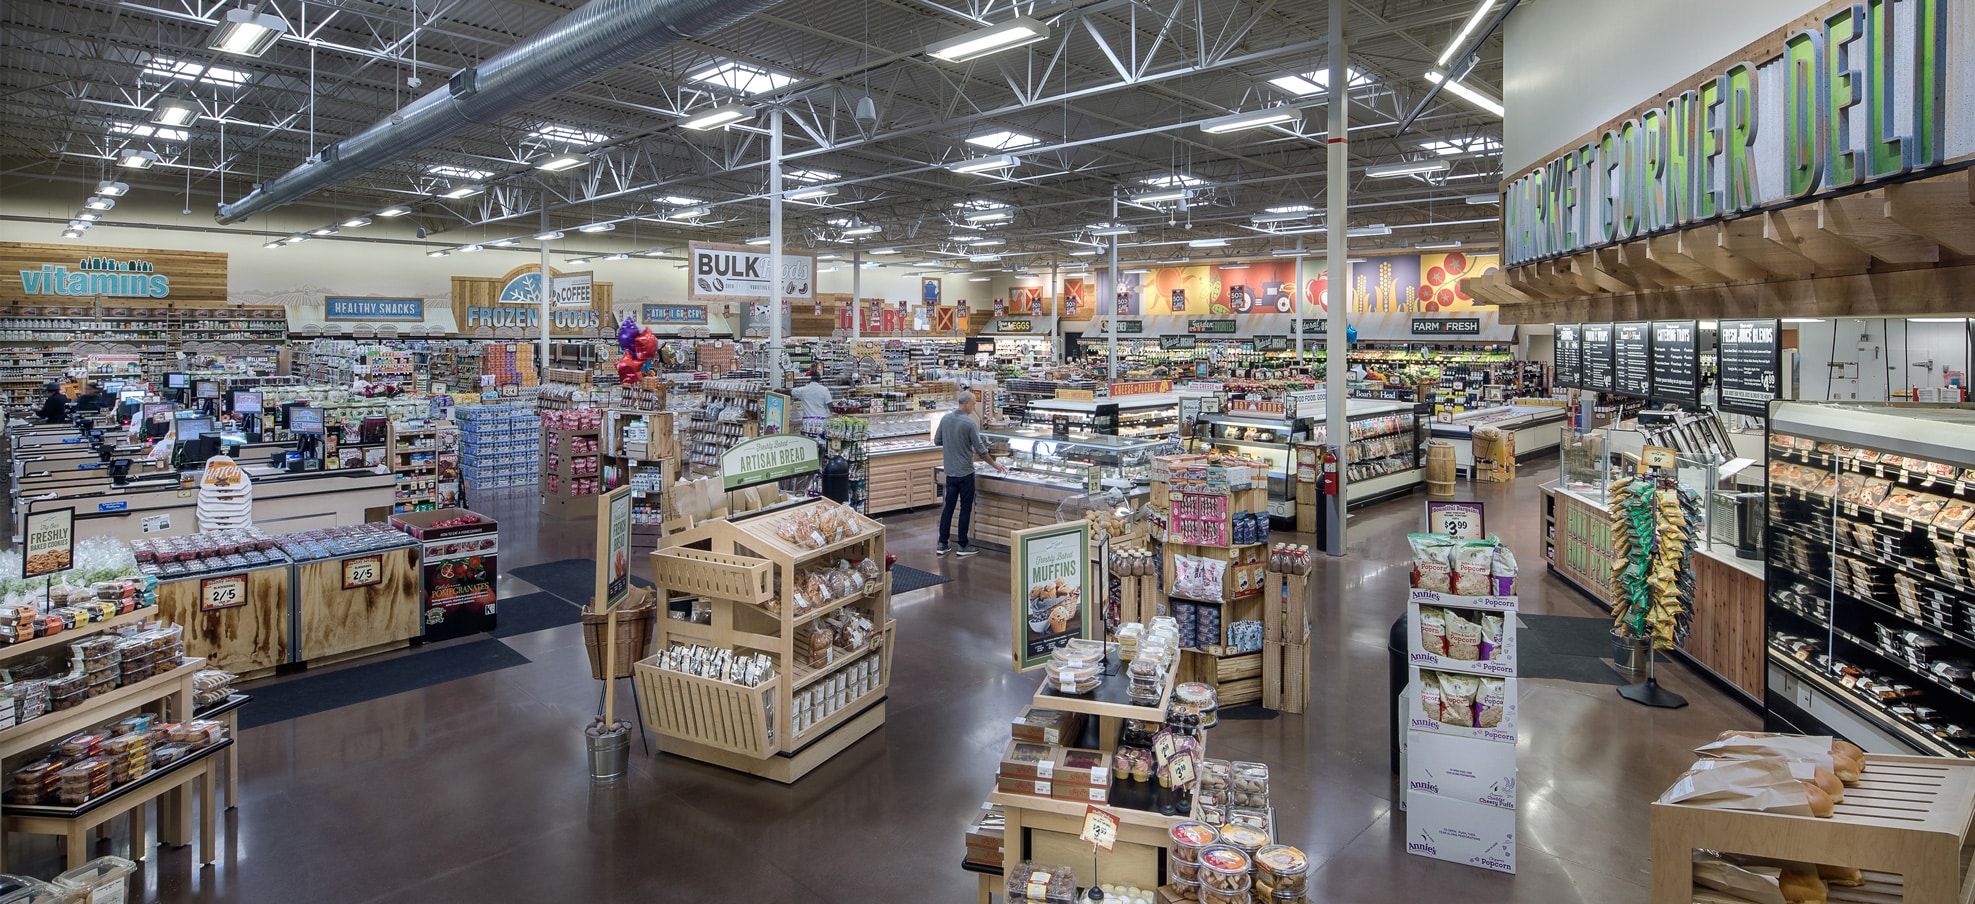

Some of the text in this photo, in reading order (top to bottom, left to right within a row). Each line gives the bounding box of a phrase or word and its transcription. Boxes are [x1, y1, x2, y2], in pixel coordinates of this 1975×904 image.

[1504, 0, 1947, 267] MARKET CORNER DELI
[698, 253, 808, 281] BULK Fods
[19, 264, 169, 298] vitamins
[561, 285, 590, 302] COFFEE
[335, 301, 415, 315] HEALTHY SNACKS
[467, 306, 600, 328] FROZEN FOODS
[1013, 321, 1030, 330] EGGS
[1192, 320, 1214, 328] Garden
[1413, 321, 1477, 332] FARM FRESH
[1722, 327, 1773, 343] FRESH JUICE BLENDS
[1114, 382, 1156, 395] CHEESE PLEASE
[1355, 390, 1396, 399] Boar's Head
[1234, 401, 1283, 413] HOT FOODS
[740, 446, 805, 472] ARTISAN BREAD
[206, 464, 241, 480] HATCH
[1431, 504, 1456, 512] Bountiful
[30, 527, 69, 544] FRESHLY
[30, 538, 69, 552] BAKED COOKIES
[1035, 550, 1074, 566] Freshly Baked
[1032, 559, 1076, 584] MUFFINS
[1421, 563, 1447, 572] Popcorn
[1460, 565, 1486, 573] Popcorn
[431, 582, 490, 598] POMEGRANATES
[434, 583, 461, 591] California
[1412, 590, 1440, 601] Annie's
[1485, 598, 1515, 608] Popcorn
[1450, 634, 1477, 643] Popcorn
[1410, 652, 1439, 664] Annie's
[1483, 663, 1513, 673] Popcorn
[1411, 718, 1439, 730] Annie's
[1484, 730, 1514, 741] Popcorn
[1410, 781, 1439, 793] Annie's
[1478, 797, 1498, 806] Cheesy
[1408, 842, 1436, 855] Annie's
[1481, 858, 1511, 870] Popcorn
